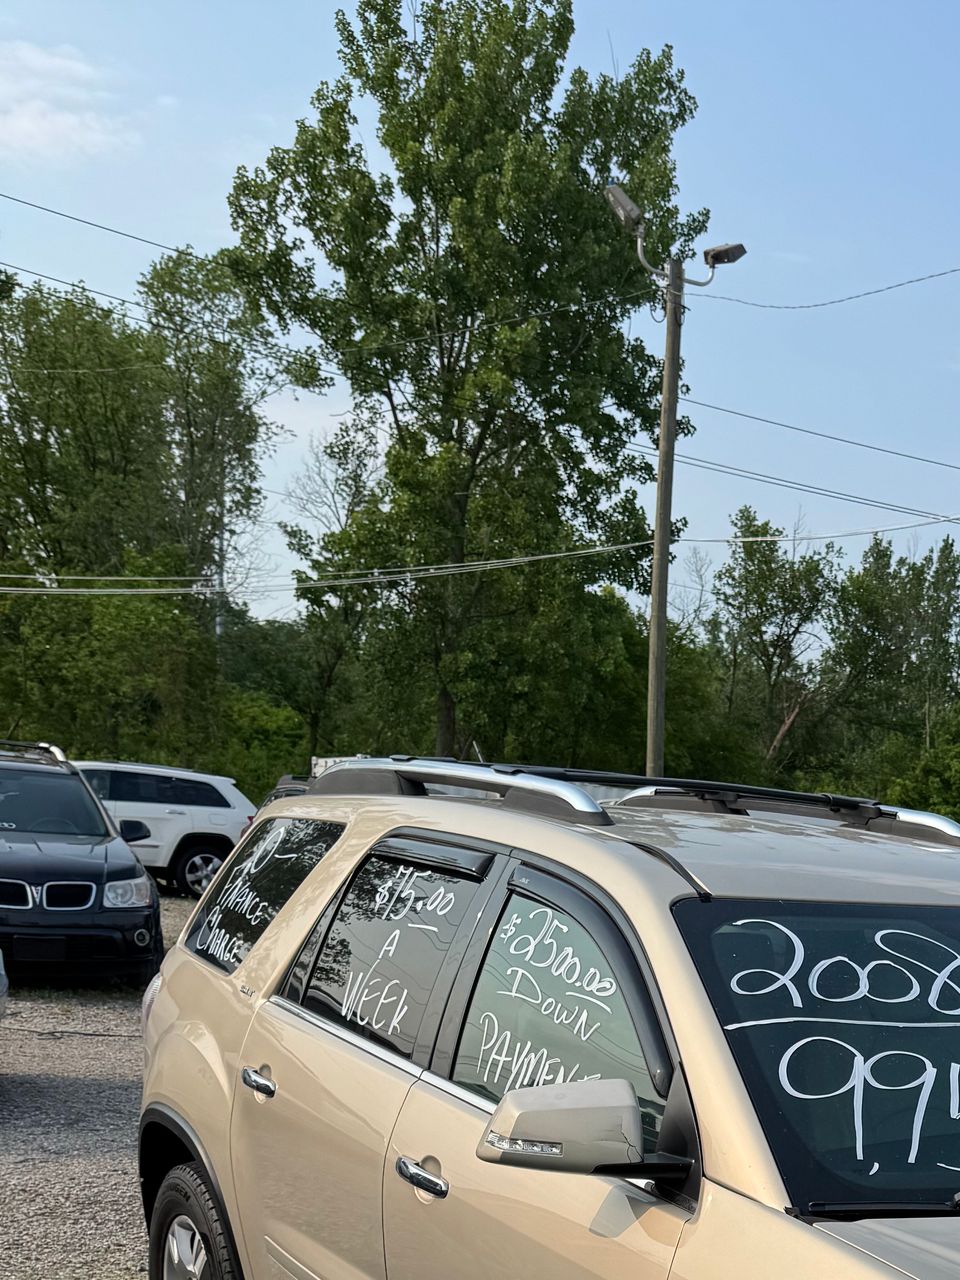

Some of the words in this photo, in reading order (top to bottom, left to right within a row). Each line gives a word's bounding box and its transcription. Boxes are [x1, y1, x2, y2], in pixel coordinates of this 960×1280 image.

[217, 863, 269, 926] FINANCE
[374, 865, 455, 920] $75.00
[378, 929, 401, 959] A
[500, 908, 616, 996] $2500.00
[341, 960, 408, 1035] WEEK
